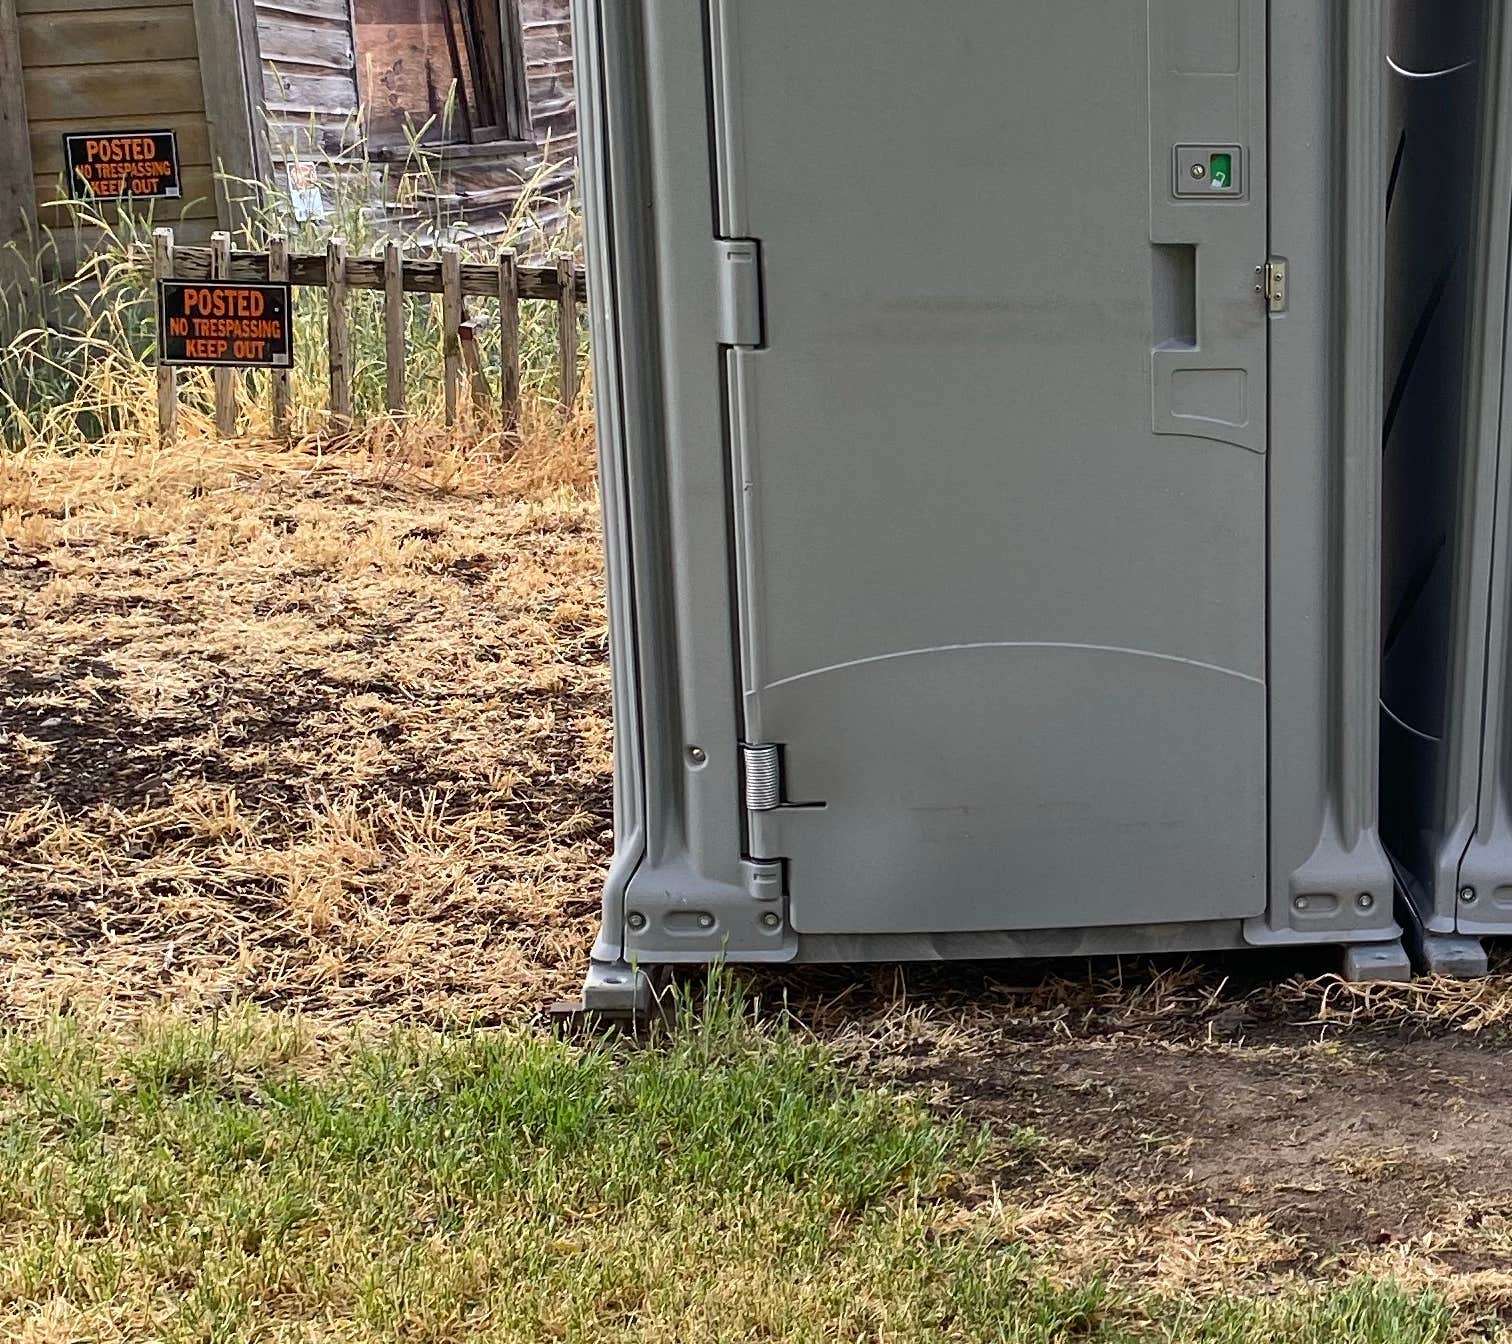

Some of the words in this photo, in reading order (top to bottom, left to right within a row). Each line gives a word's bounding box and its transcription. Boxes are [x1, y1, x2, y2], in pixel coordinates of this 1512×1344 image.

[86, 139, 156, 162] POSTED
[95, 161, 171, 179] TRESPASSING
[132, 178, 159, 194] OUT
[184, 288, 264, 316] POSTED
[170, 319, 189, 336] NO
[194, 317, 281, 339] TRESPASSING
[186, 340, 227, 358] KEEP
[234, 340, 265, 359] OUT
